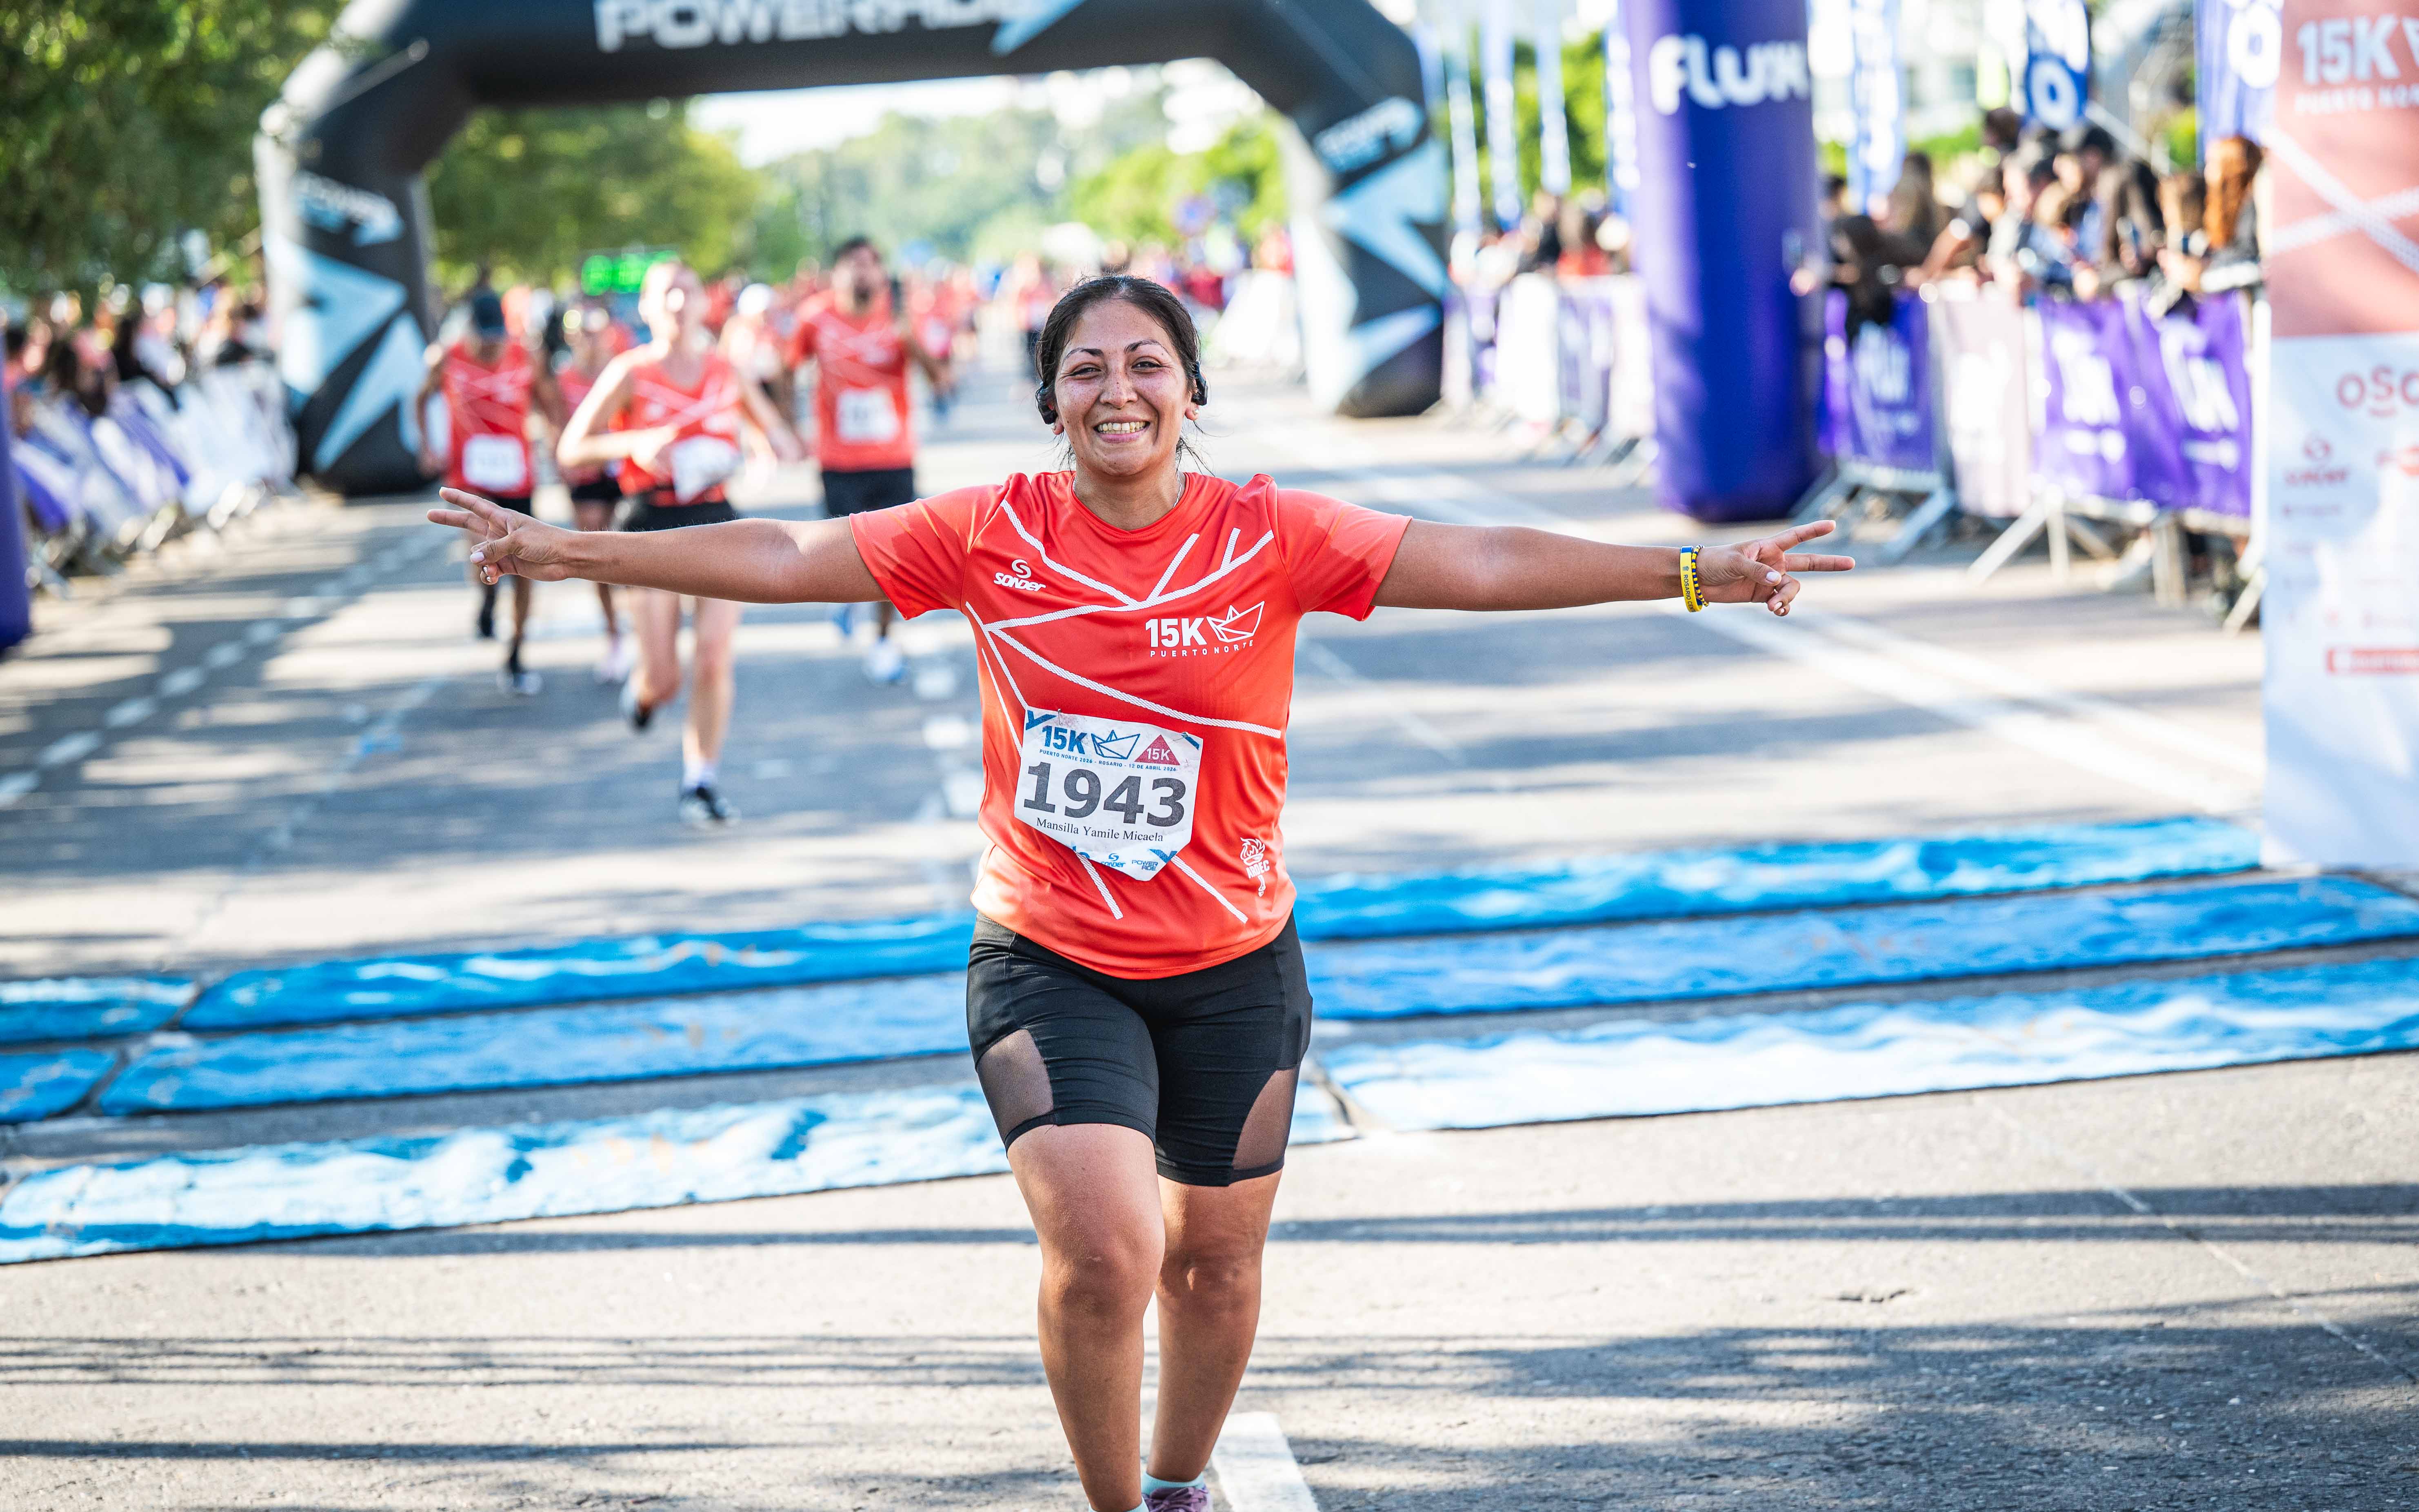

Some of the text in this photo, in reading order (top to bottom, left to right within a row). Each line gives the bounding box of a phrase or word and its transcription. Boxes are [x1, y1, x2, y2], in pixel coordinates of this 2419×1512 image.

[2297, 13, 2401, 85] 15K
[1145, 617, 1207, 648] 15K
[1150, 639, 1254, 657] PUERTO NORTE
[1040, 749, 1060, 757] PUERTO
[1042, 725, 1088, 755] 15K
[1147, 747, 1171, 761] 15K
[1024, 762, 1186, 827] 1943
[1037, 817, 1164, 842] Mansilla Yamile Micaela
